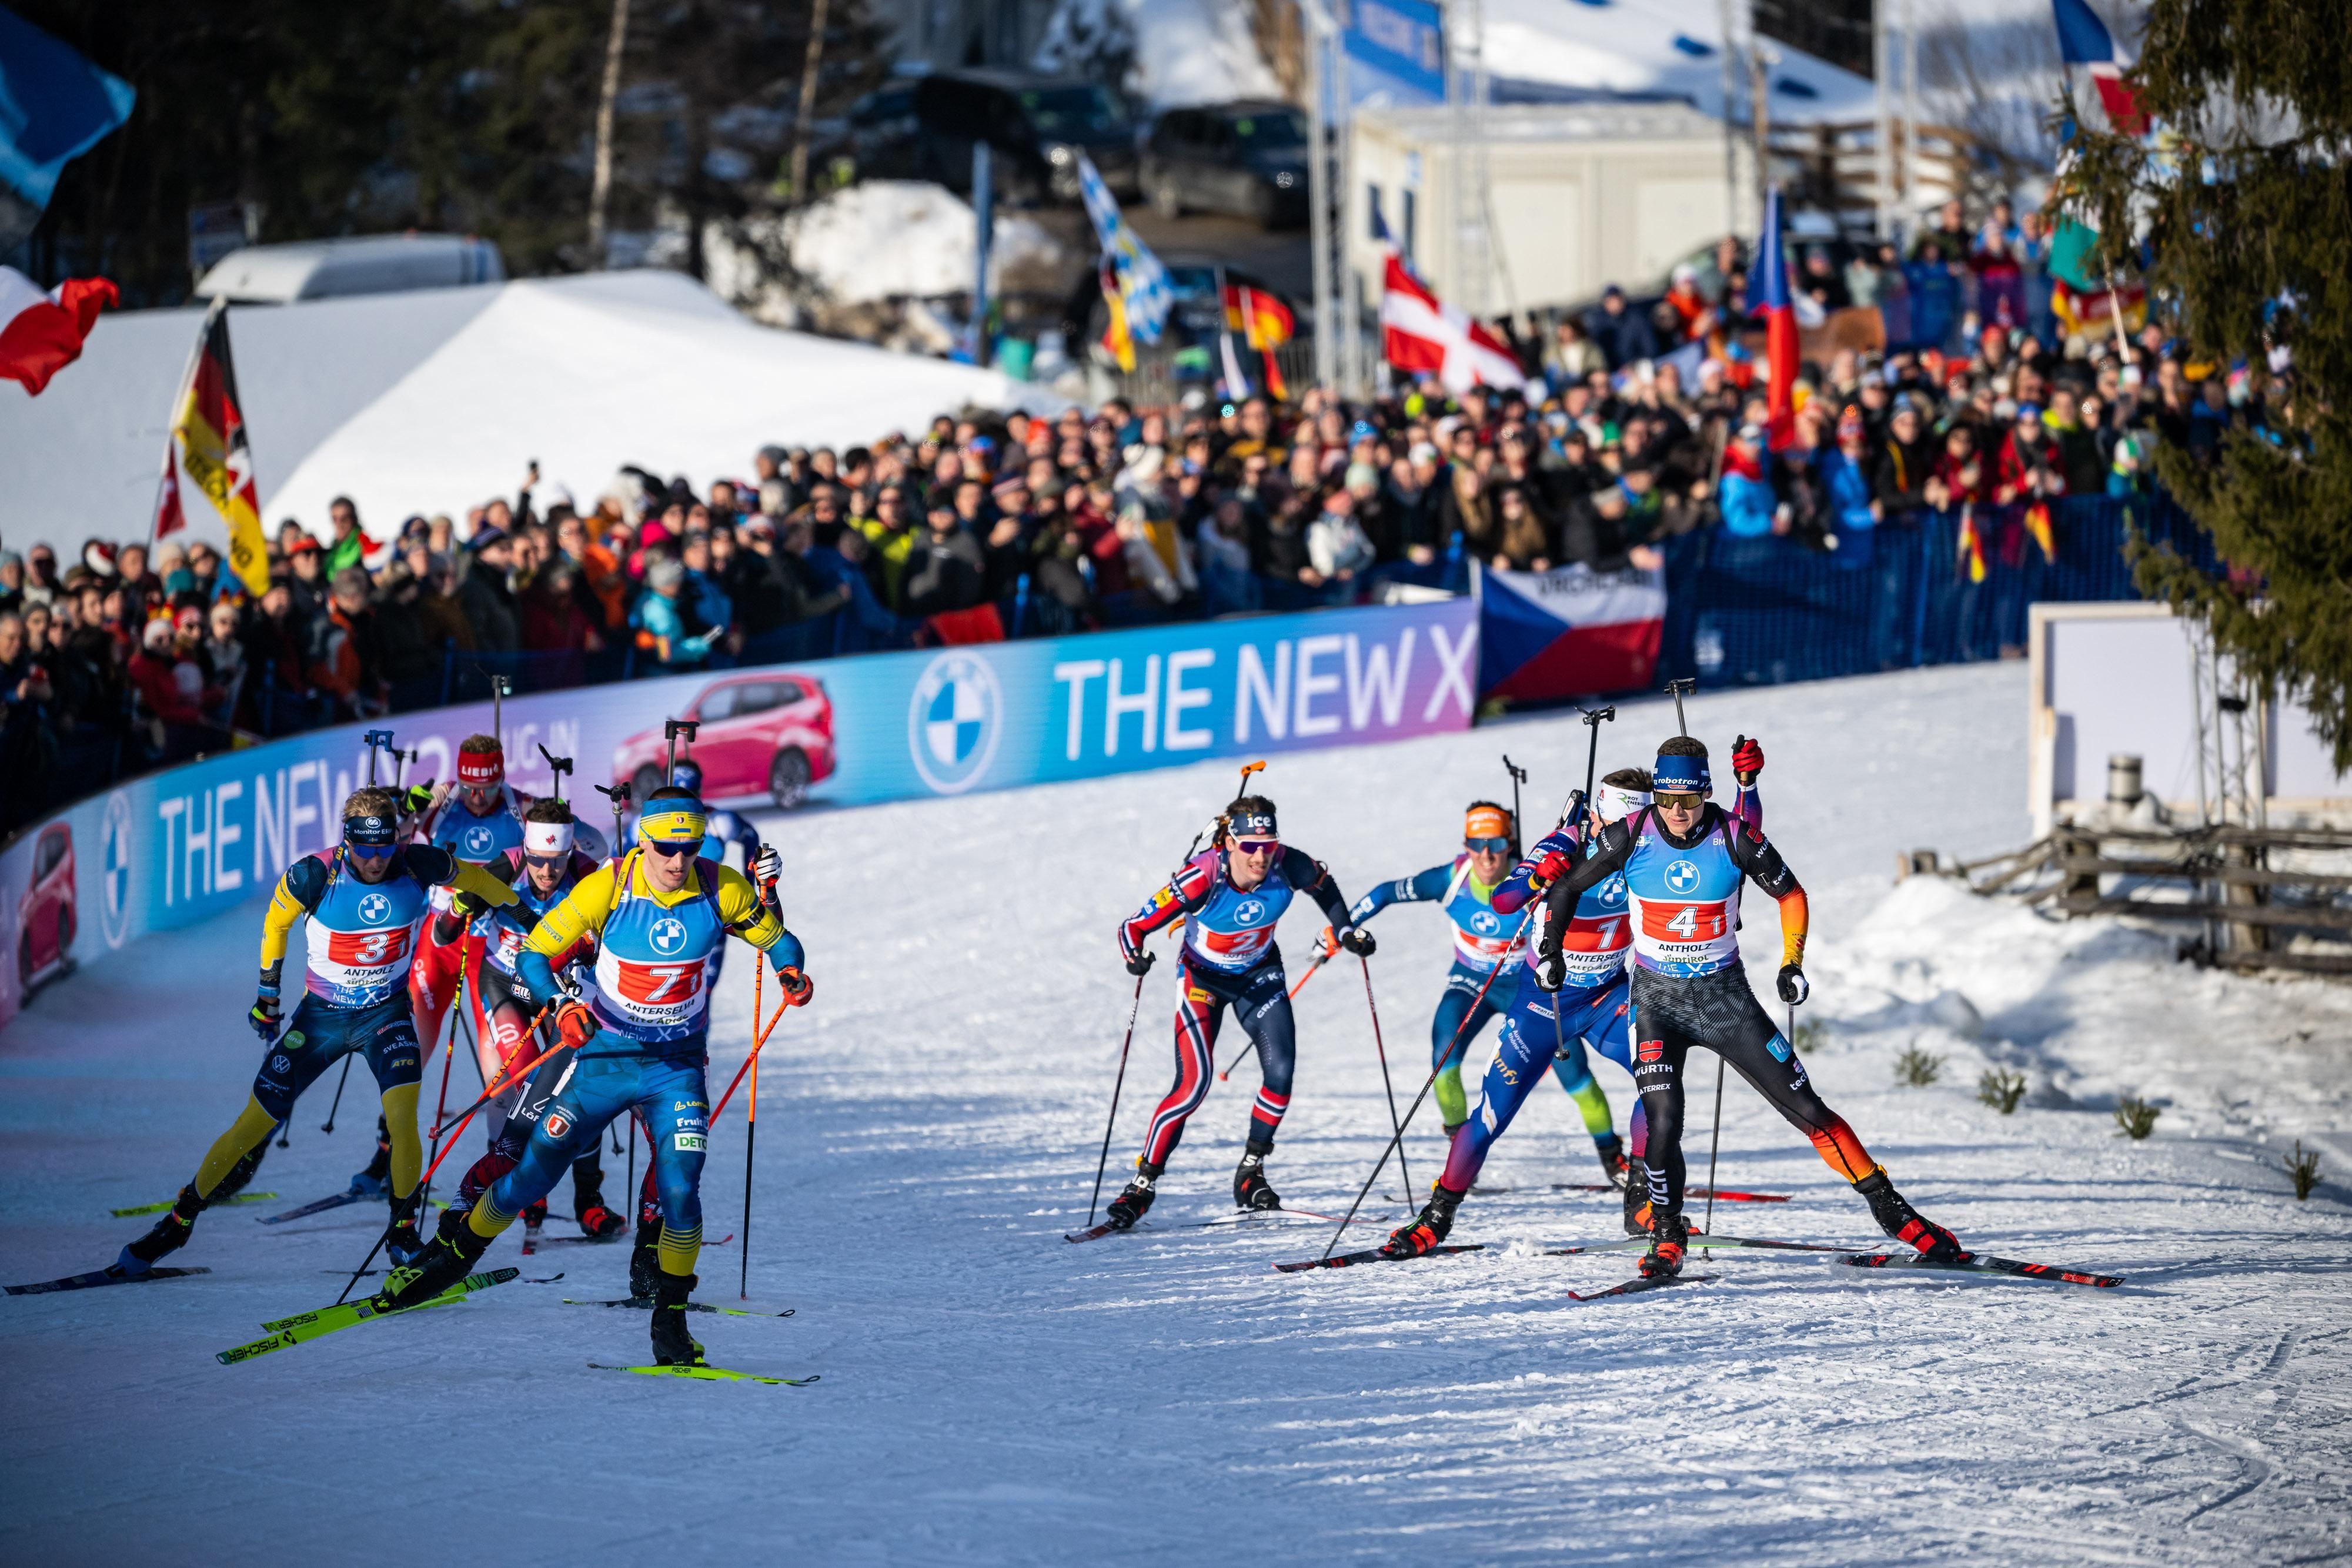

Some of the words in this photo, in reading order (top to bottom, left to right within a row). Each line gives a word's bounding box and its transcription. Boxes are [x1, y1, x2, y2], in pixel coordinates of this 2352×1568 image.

[1054, 648, 1215, 760] THE
[1235, 625, 1416, 744] NEW
[1424, 621, 1478, 723] X
[1658, 777, 1698, 785] robotron
[1247, 814, 1271, 828] ice
[158, 780, 243, 907] THE
[1538, 841, 1564, 851] CRAFT
[1601, 828, 1614, 852] TERREX
[1712, 838, 1726, 846] BM
[1755, 837, 1770, 859] WÜR
[335, 846, 344, 861] ATG
[1669, 861, 1696, 872] BMW
[327, 868, 337, 885] ATG
[1772, 864, 1788, 886] tect
[362, 894, 386, 906] BMW
[654, 920, 681, 932] BMW
[1666, 906, 1699, 939] 4
[1710, 915, 1721, 935] 1
[1596, 917, 1622, 950] 1
[355, 932, 389, 964] 3
[397, 937, 406, 958] 1
[1228, 931, 1261, 954] 2
[1658, 942, 1713, 952] ANTHOLZ
[343, 964, 395, 977] ANTHOLZ
[335, 984, 356, 995] THE
[644, 966, 686, 1002] 7
[333, 992, 357, 1005] NEW
[362, 984, 392, 1005] X3
[624, 998, 696, 1015] ANTERSELVA
[286, 1034, 303, 1045] dina
[619, 1029, 647, 1042] NEW
[654, 1021, 690, 1042] X3
[383, 1041, 420, 1054] SVEASKO
[1507, 1032, 1529, 1064] Rhône-Alpes
[392, 1058, 415, 1068] ATG
[1634, 1063, 1673, 1079] WÜRTH
[1643, 1083, 1671, 1094] TERREX
[521, 1106, 540, 1122] LÖF
[676, 1117, 703, 1127] Fruit
[550, 1119, 563, 1134] 1
[1643, 1161, 1670, 1205] GER
[462, 1272, 497, 1292] MAX
[2060, 1272, 2096, 1285] ROSSIGN
[278, 1312, 319, 1330] FISCHER
[228, 1336, 280, 1362] FISCHER
